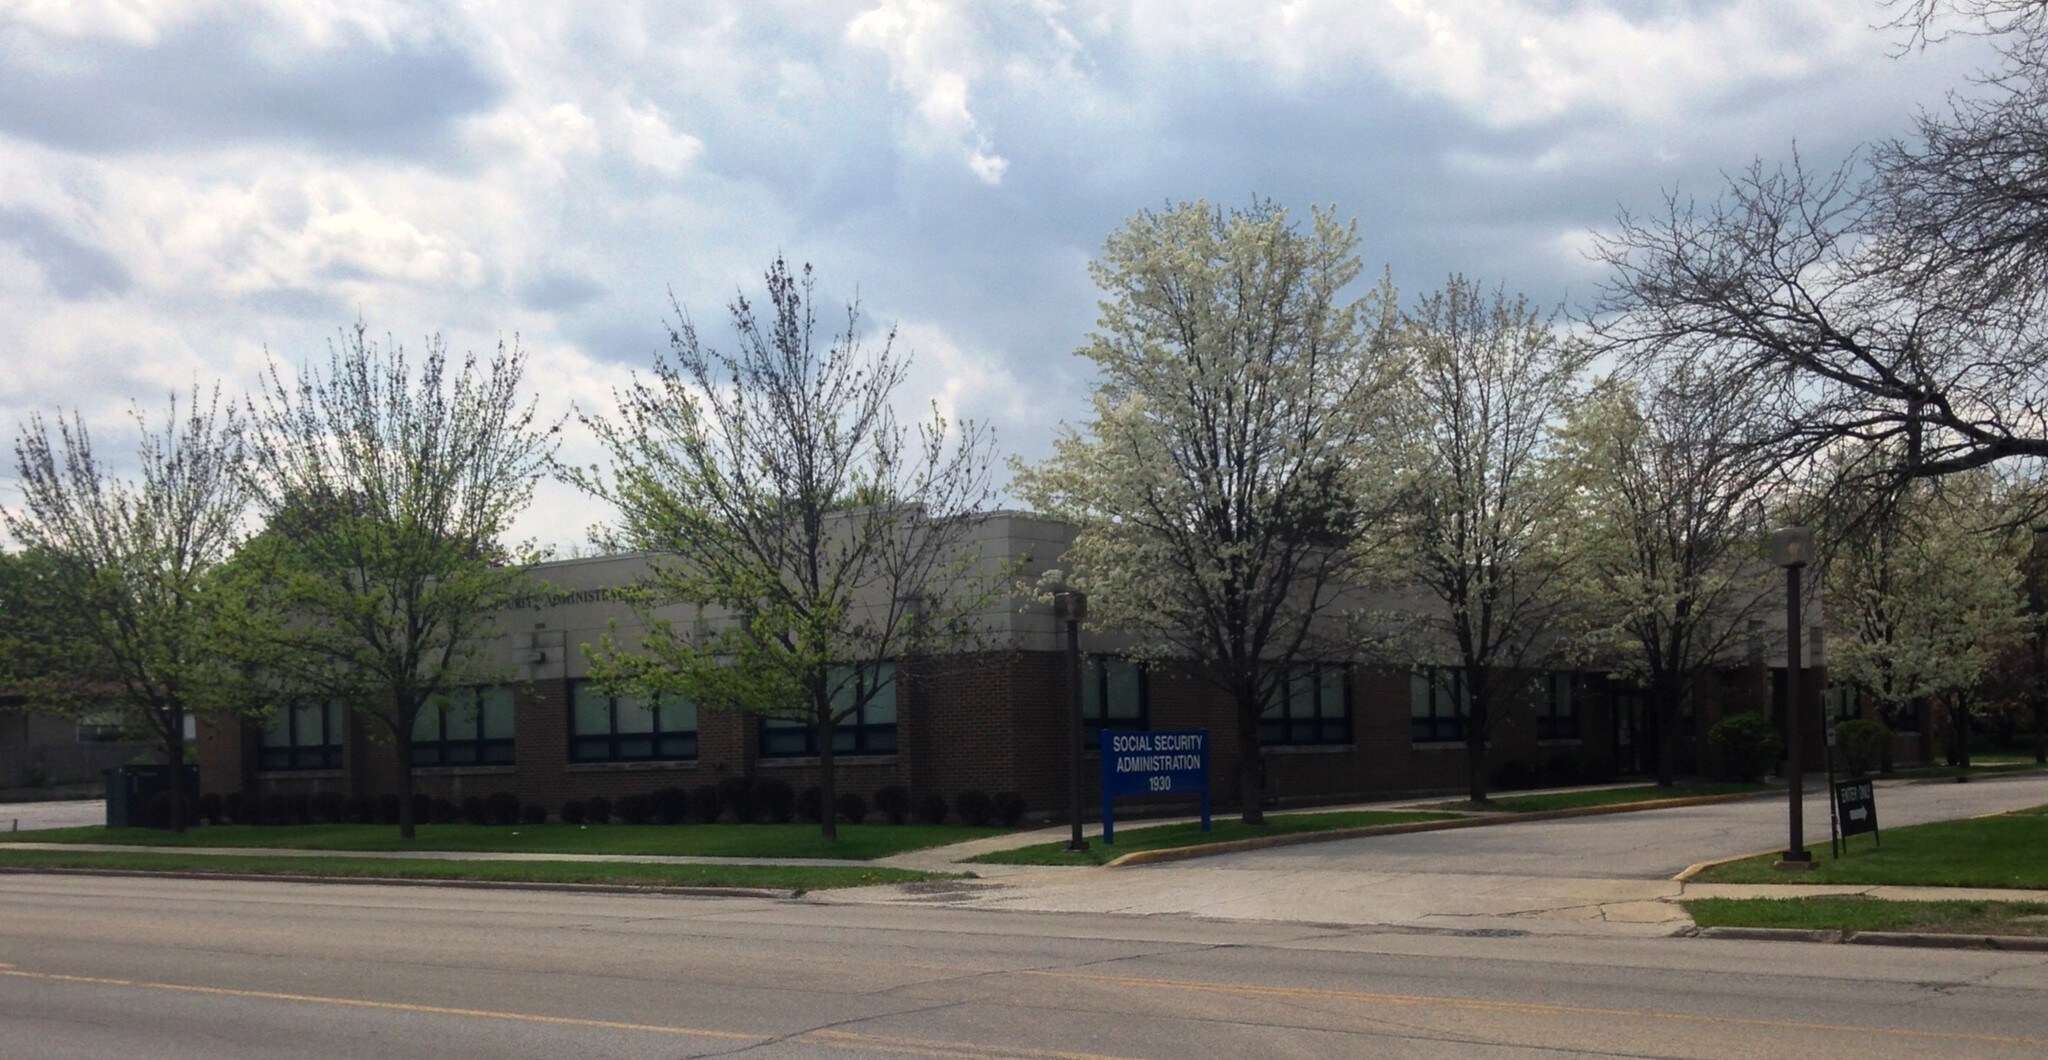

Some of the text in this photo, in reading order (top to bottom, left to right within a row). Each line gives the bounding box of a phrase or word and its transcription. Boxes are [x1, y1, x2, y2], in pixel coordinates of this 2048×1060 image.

[1113, 735, 1202, 752] SOCIAL SECURITY
[1116, 755, 1200, 772] ADMINISTRATION
[1149, 776, 1171, 791] 1930
